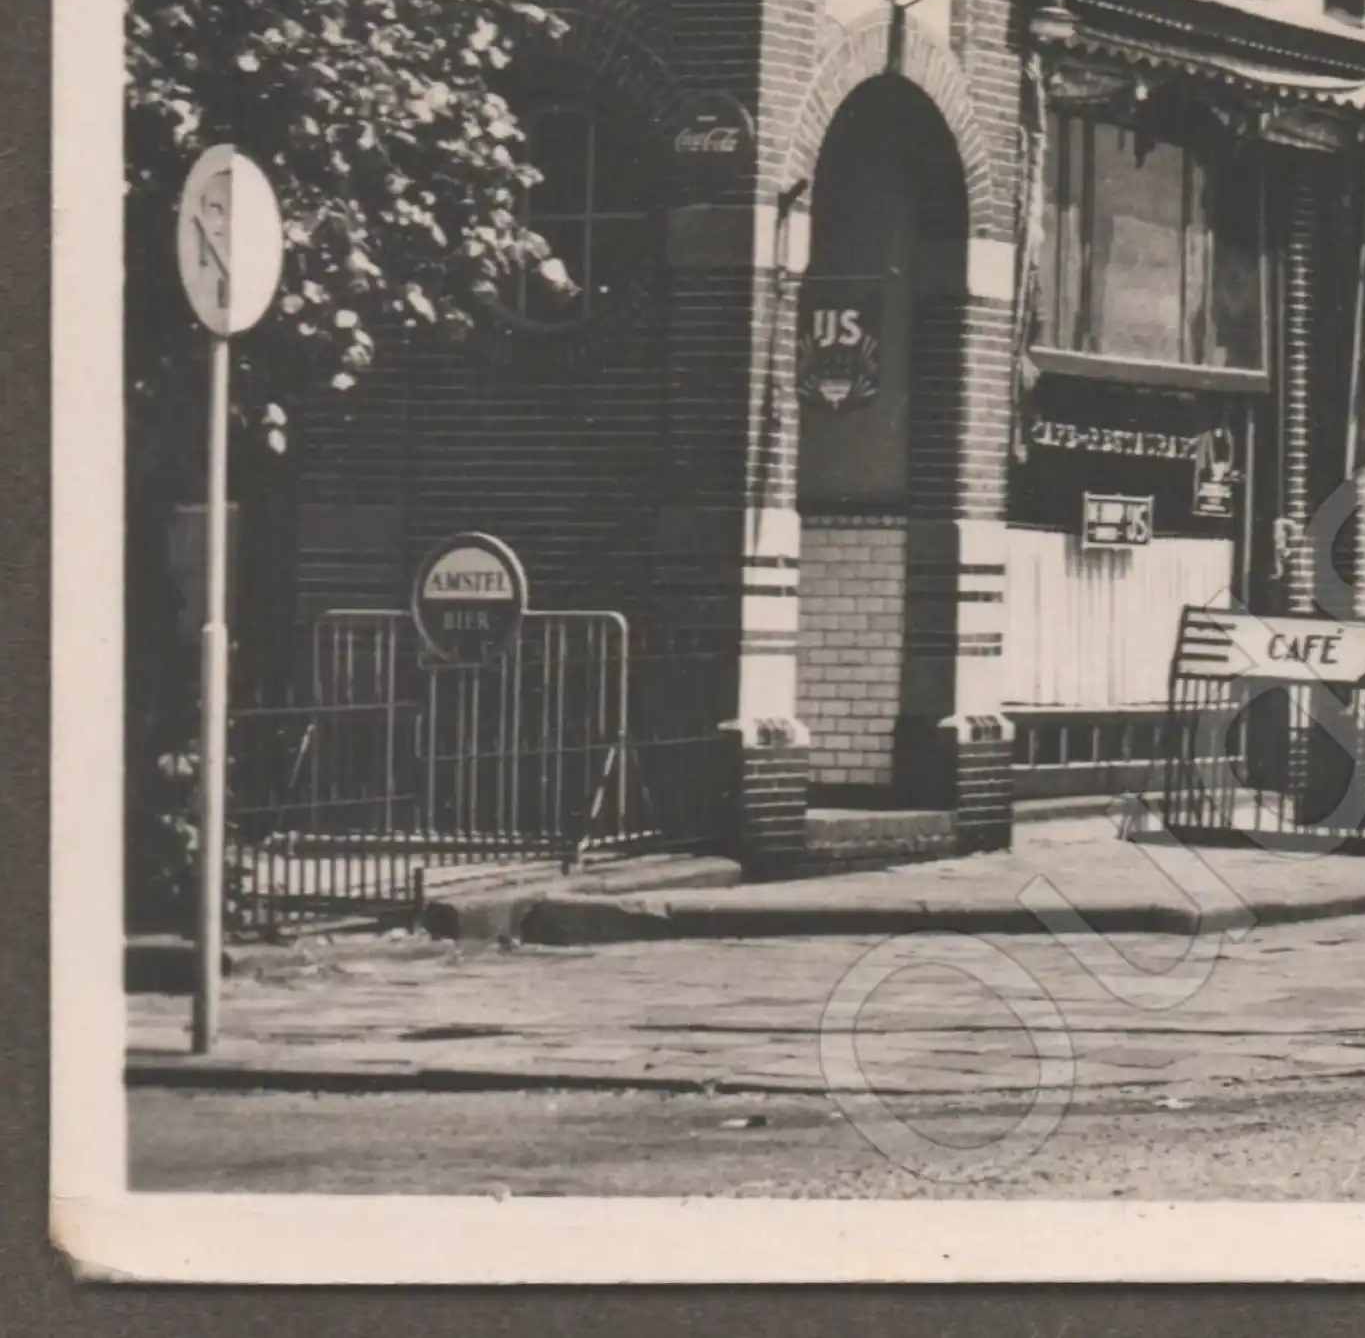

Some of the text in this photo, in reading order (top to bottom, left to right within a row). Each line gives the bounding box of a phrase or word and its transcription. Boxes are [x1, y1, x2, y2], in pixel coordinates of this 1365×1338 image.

[813, 309, 862, 348] IJS
[432, 570, 507, 592] AMSTEL
[443, 610, 490, 631] BIER
[1267, 627, 1343, 665] CAFÉ
